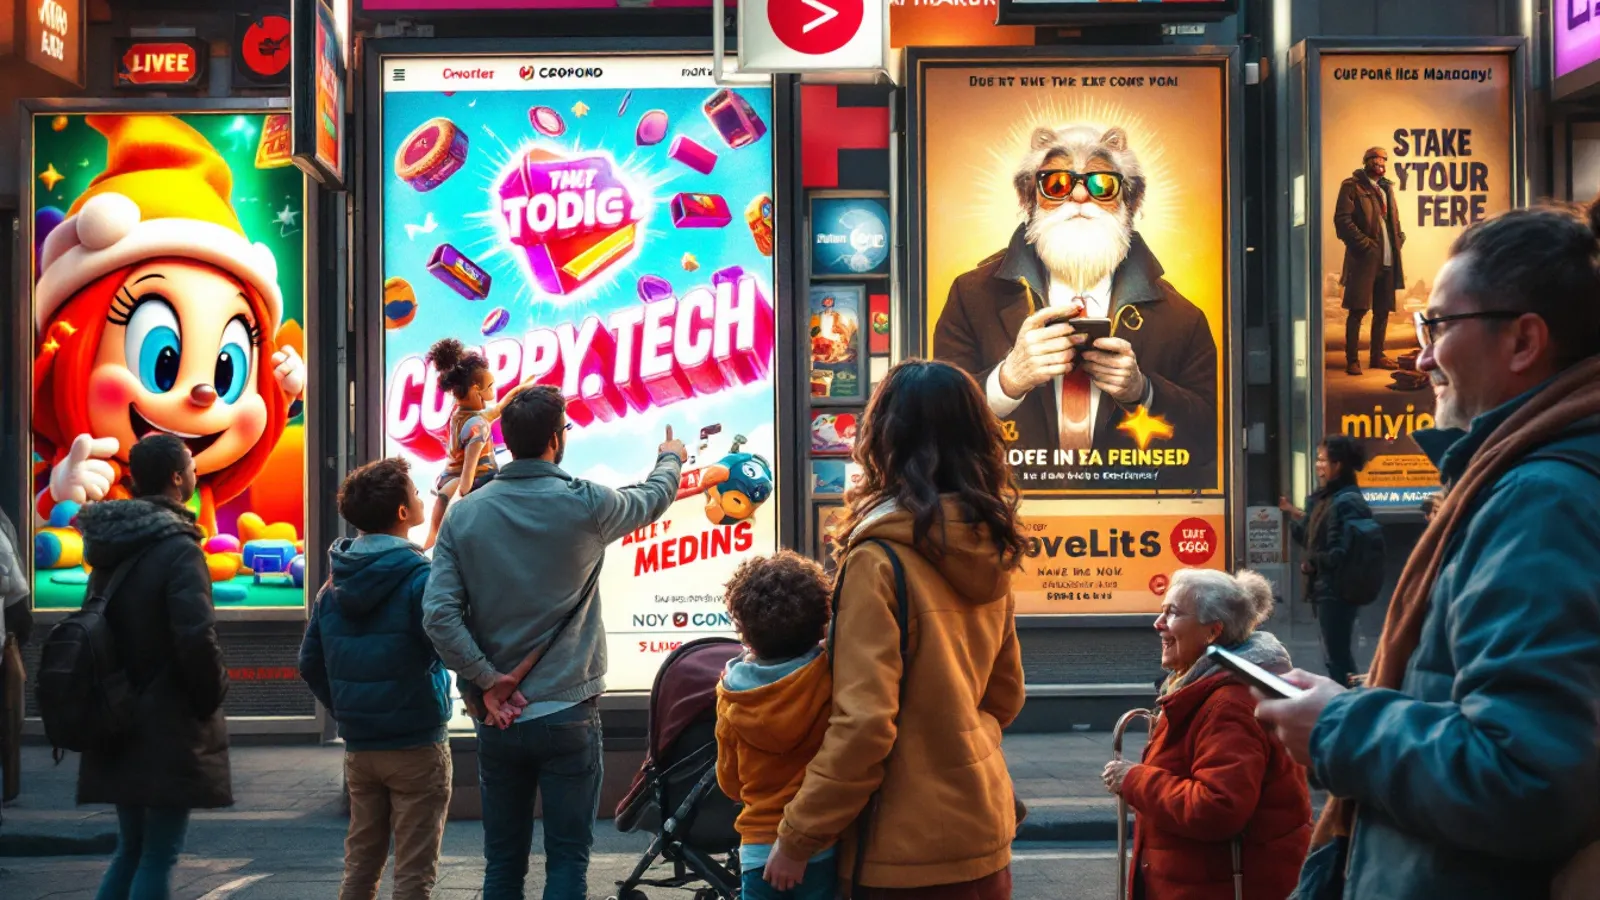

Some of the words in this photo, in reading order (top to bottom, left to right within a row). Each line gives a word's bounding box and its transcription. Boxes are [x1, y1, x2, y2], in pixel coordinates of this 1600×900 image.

[132, 53, 190, 73] LIVEE
[1393, 128, 1472, 157] STAKE
[1394, 161, 1489, 192] YTOUR
[1416, 195, 1487, 227] FERE
[1053, 448, 1074, 466] IN
[633, 520, 754, 577] MEDINS
[632, 613, 669, 627] NOY
